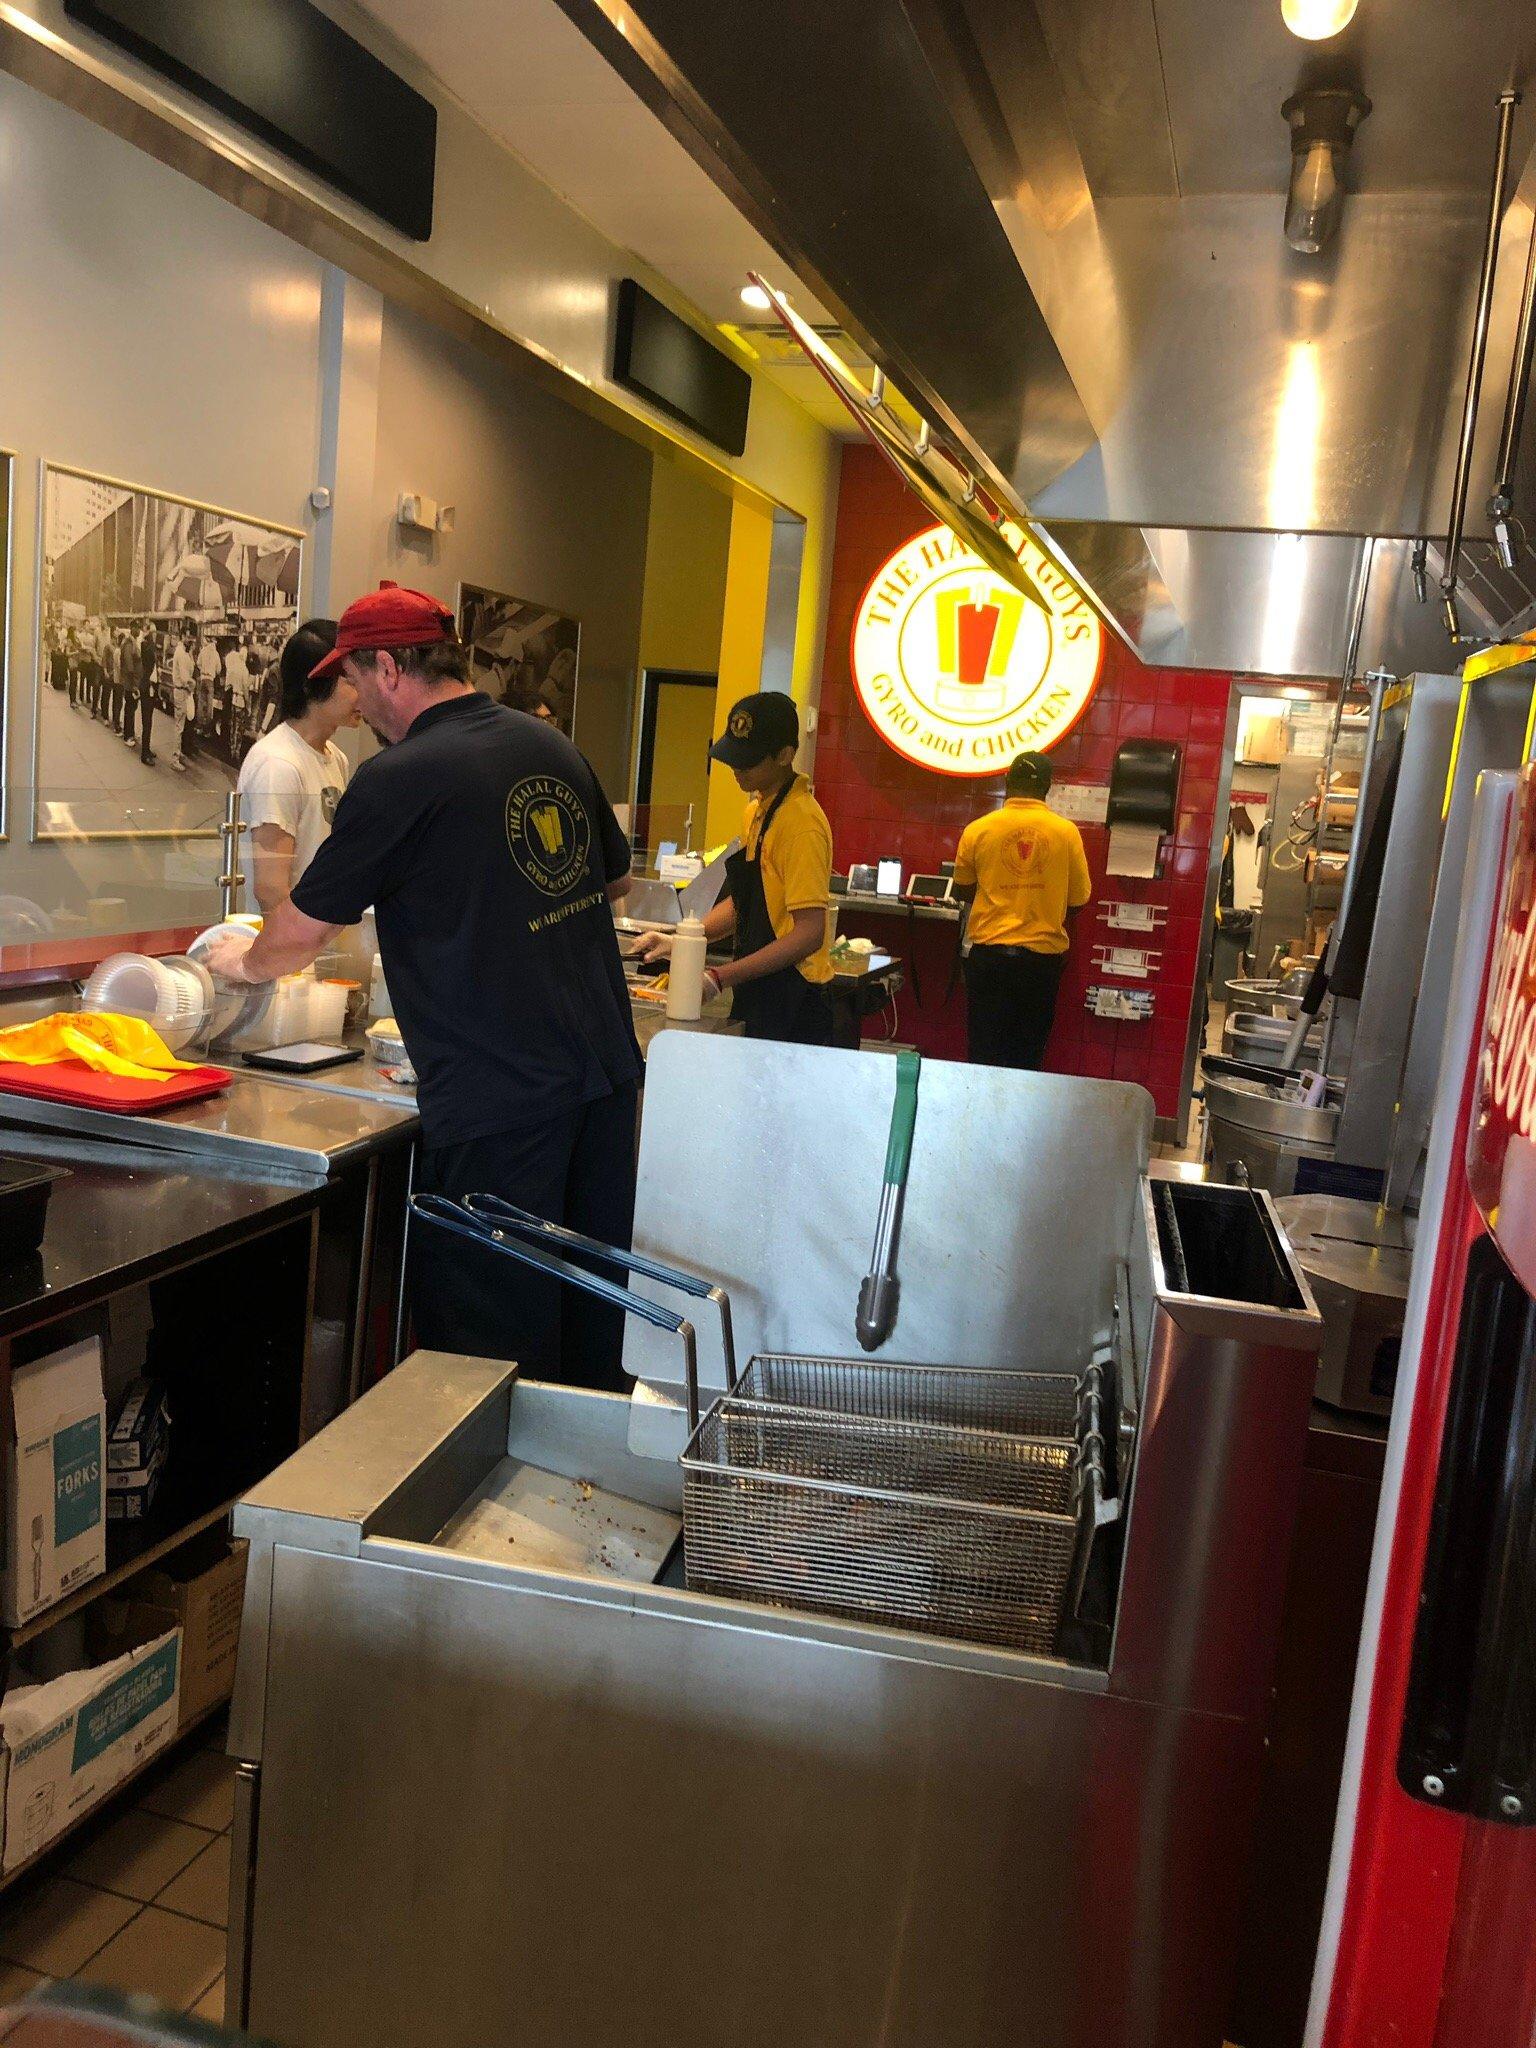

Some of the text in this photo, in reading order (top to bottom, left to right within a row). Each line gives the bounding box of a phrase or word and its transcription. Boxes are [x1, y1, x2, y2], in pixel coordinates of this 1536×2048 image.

[867, 533, 1091, 642] THE HAL GUYS
[871, 672, 1072, 760] GYRO and CHICKEN
[509, 780, 585, 843] THE HALAL GUYS
[57, 1460, 99, 1500] FORKS
